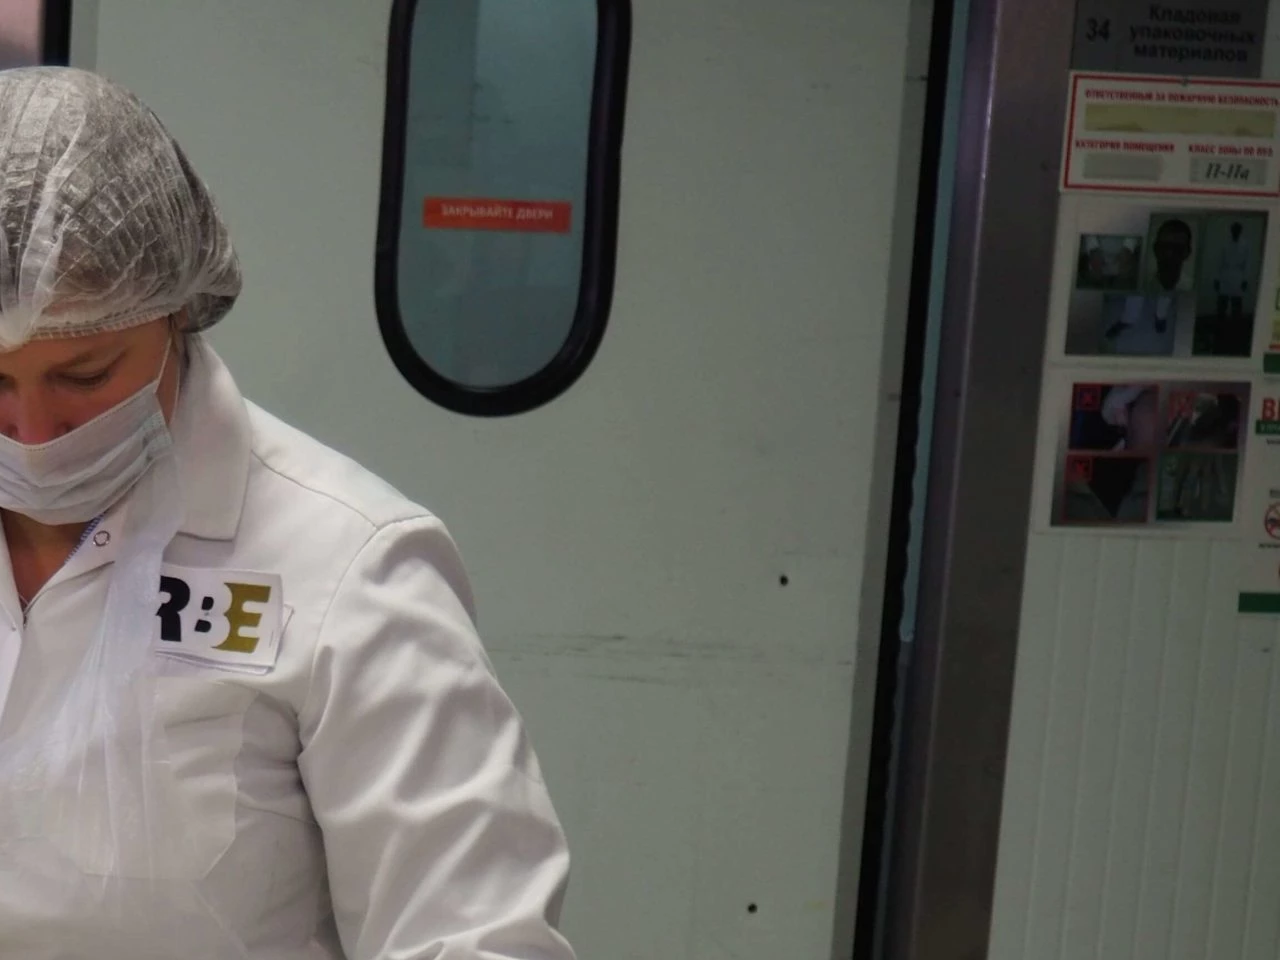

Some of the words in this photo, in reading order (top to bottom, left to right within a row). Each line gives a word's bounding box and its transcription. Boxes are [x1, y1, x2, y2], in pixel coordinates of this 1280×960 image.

[1150, 5, 1241, 25] Кладовая
[1086, 17, 1111, 42] 34
[1129, 24, 1257, 44] упаковочных
[1134, 44, 1248, 62] материалов
[441, 203, 514, 218] ЗАКРЫВАЙТЕ
[516, 207, 553, 220] ДВЕРИ
